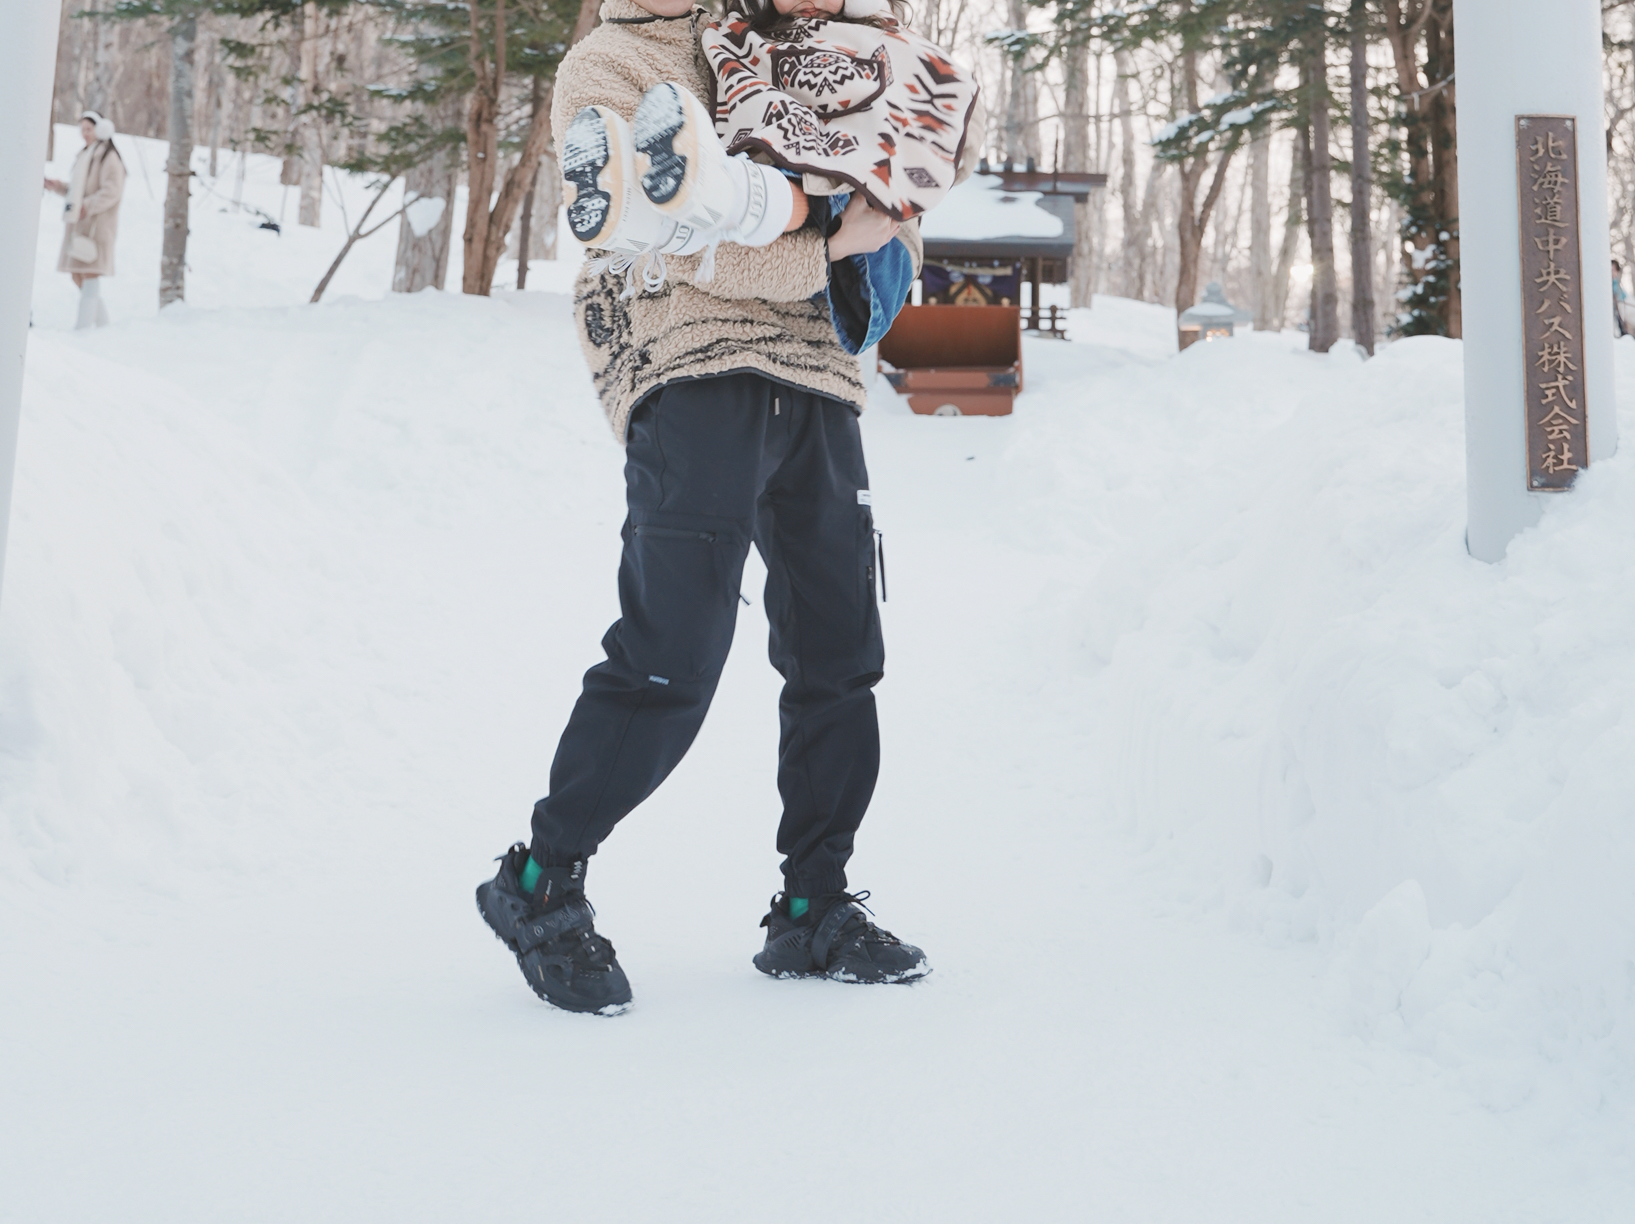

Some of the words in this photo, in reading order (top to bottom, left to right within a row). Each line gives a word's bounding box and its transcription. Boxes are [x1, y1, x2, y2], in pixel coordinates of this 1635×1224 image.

[1529, 131, 1580, 474] 北海道中央バス株式会社
